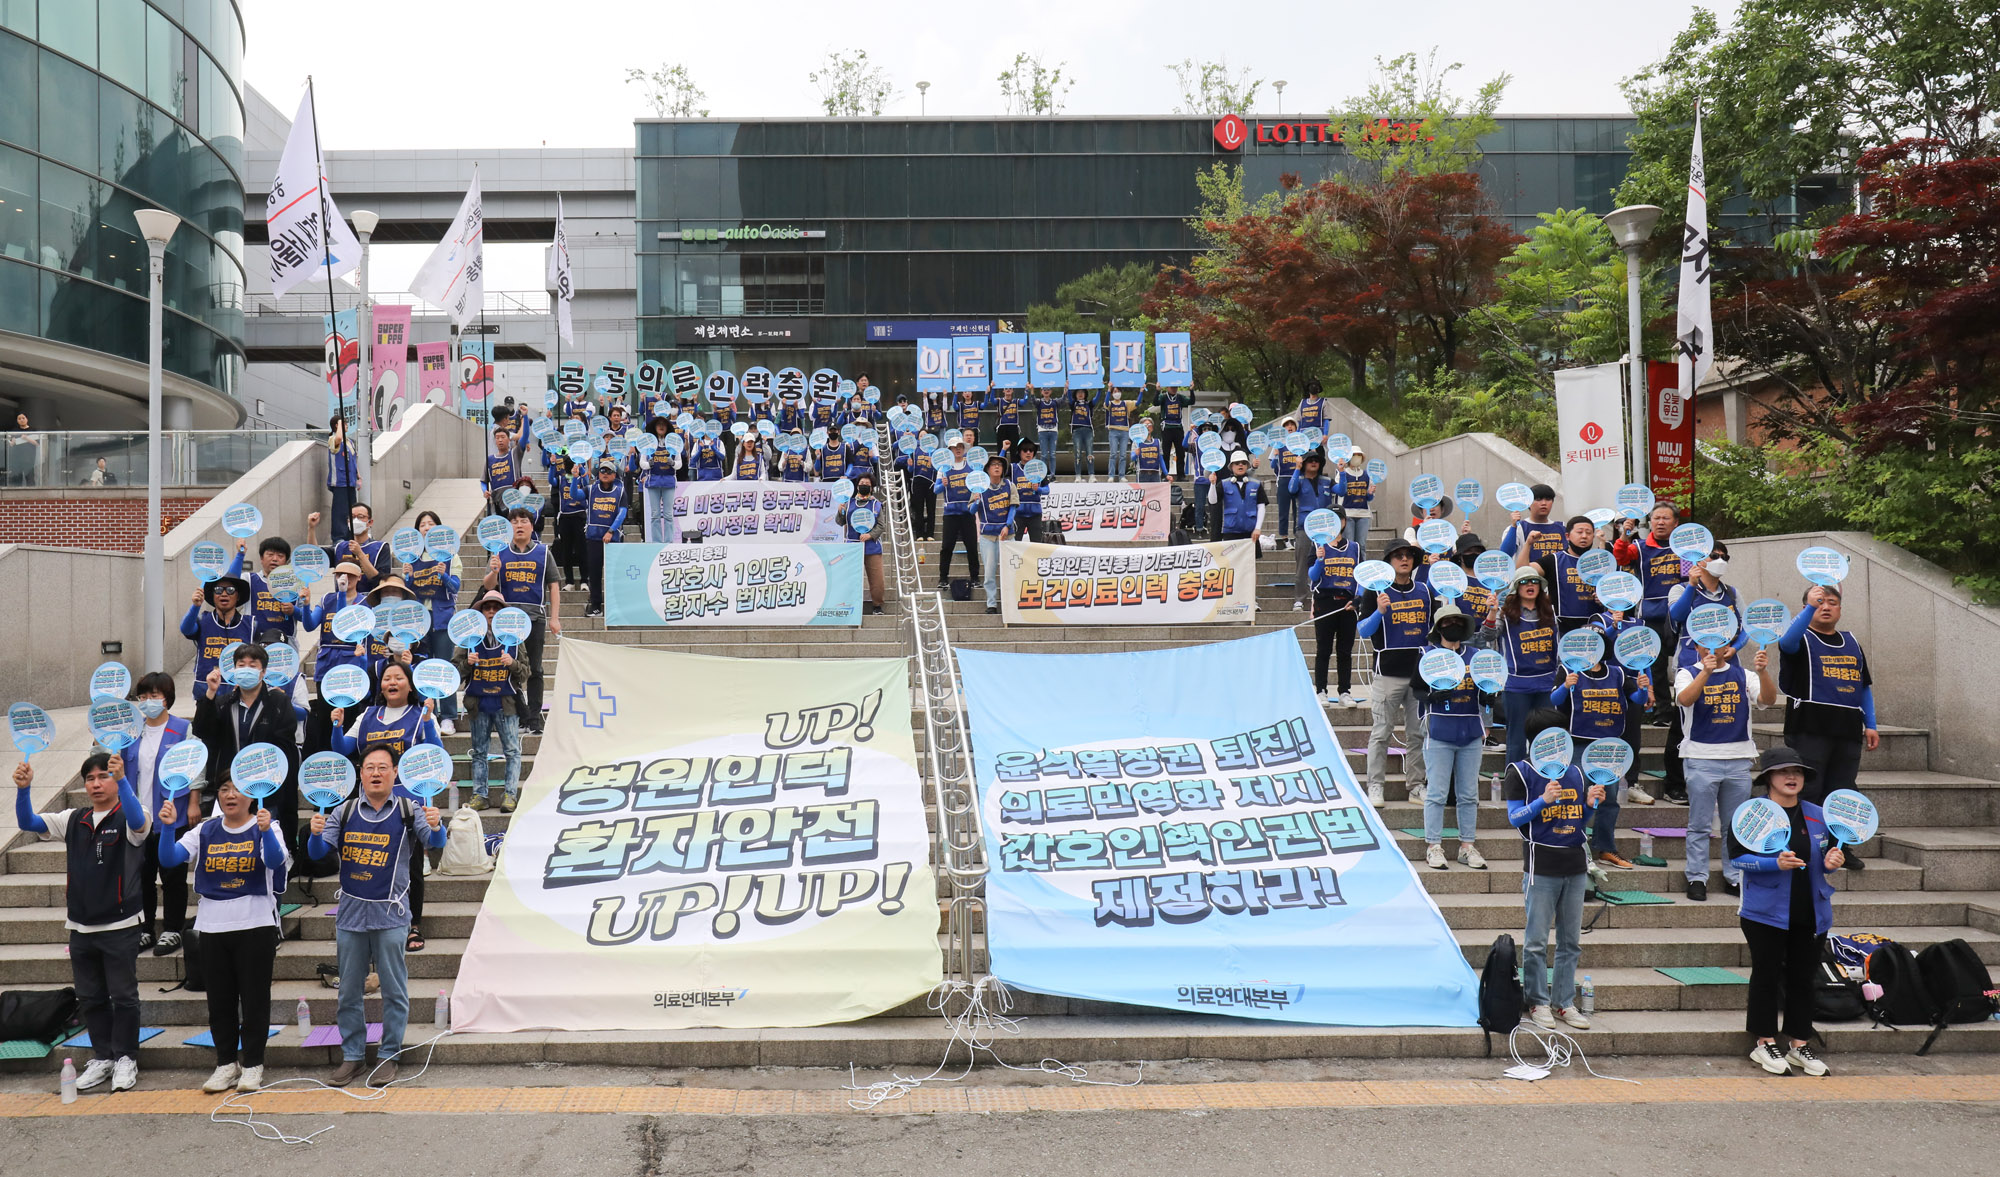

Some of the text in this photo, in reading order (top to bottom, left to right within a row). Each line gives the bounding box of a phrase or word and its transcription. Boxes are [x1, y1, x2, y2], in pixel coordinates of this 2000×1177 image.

[725, 224, 800, 240] autoOasis
[919, 340, 1188, 378] 의료민영화 저지
[1566, 446, 1620, 464] 롯데마트
[1657, 441, 1682, 456] MUJI
[694, 493, 757, 515] 비정규직
[761, 489, 832, 510] 정규직화!
[1061, 493, 1073, 508] 및
[1074, 491, 1119, 507] 노동개악
[1120, 489, 1146, 503] 저지!
[697, 512, 802, 537] 의사정원 확대!
[1058, 505, 1147, 531] 정권 퇴진!
[659, 546, 727, 566] 간호인력 충원!
[1037, 549, 1204, 577] 병원인력 직종별 기준마련
[505, 571, 537, 584] 인력충원!
[662, 556, 791, 594] 간호사 1인당
[664, 582, 807, 621] 환자수 법제화!
[1017, 567, 1234, 610] 보건의료인력 충원!
[473, 669, 508, 682] 인력충원!
[764, 688, 882, 750] UP!
[995, 716, 1315, 782] 윤석열정권 퇴진!
[1000, 766, 1338, 825] 의료민영화 저지!
[543, 799, 880, 889] 환자안전
[1000, 806, 1380, 873] 간호인력인권법
[205, 856, 256, 872] 인력충원!
[342, 845, 389, 867] 인력충원!
[1092, 865, 1348, 927] 제정하라!
[653, 991, 735, 1009] 의료연대본부
[1177, 987, 1290, 1011] 의료연대본부
